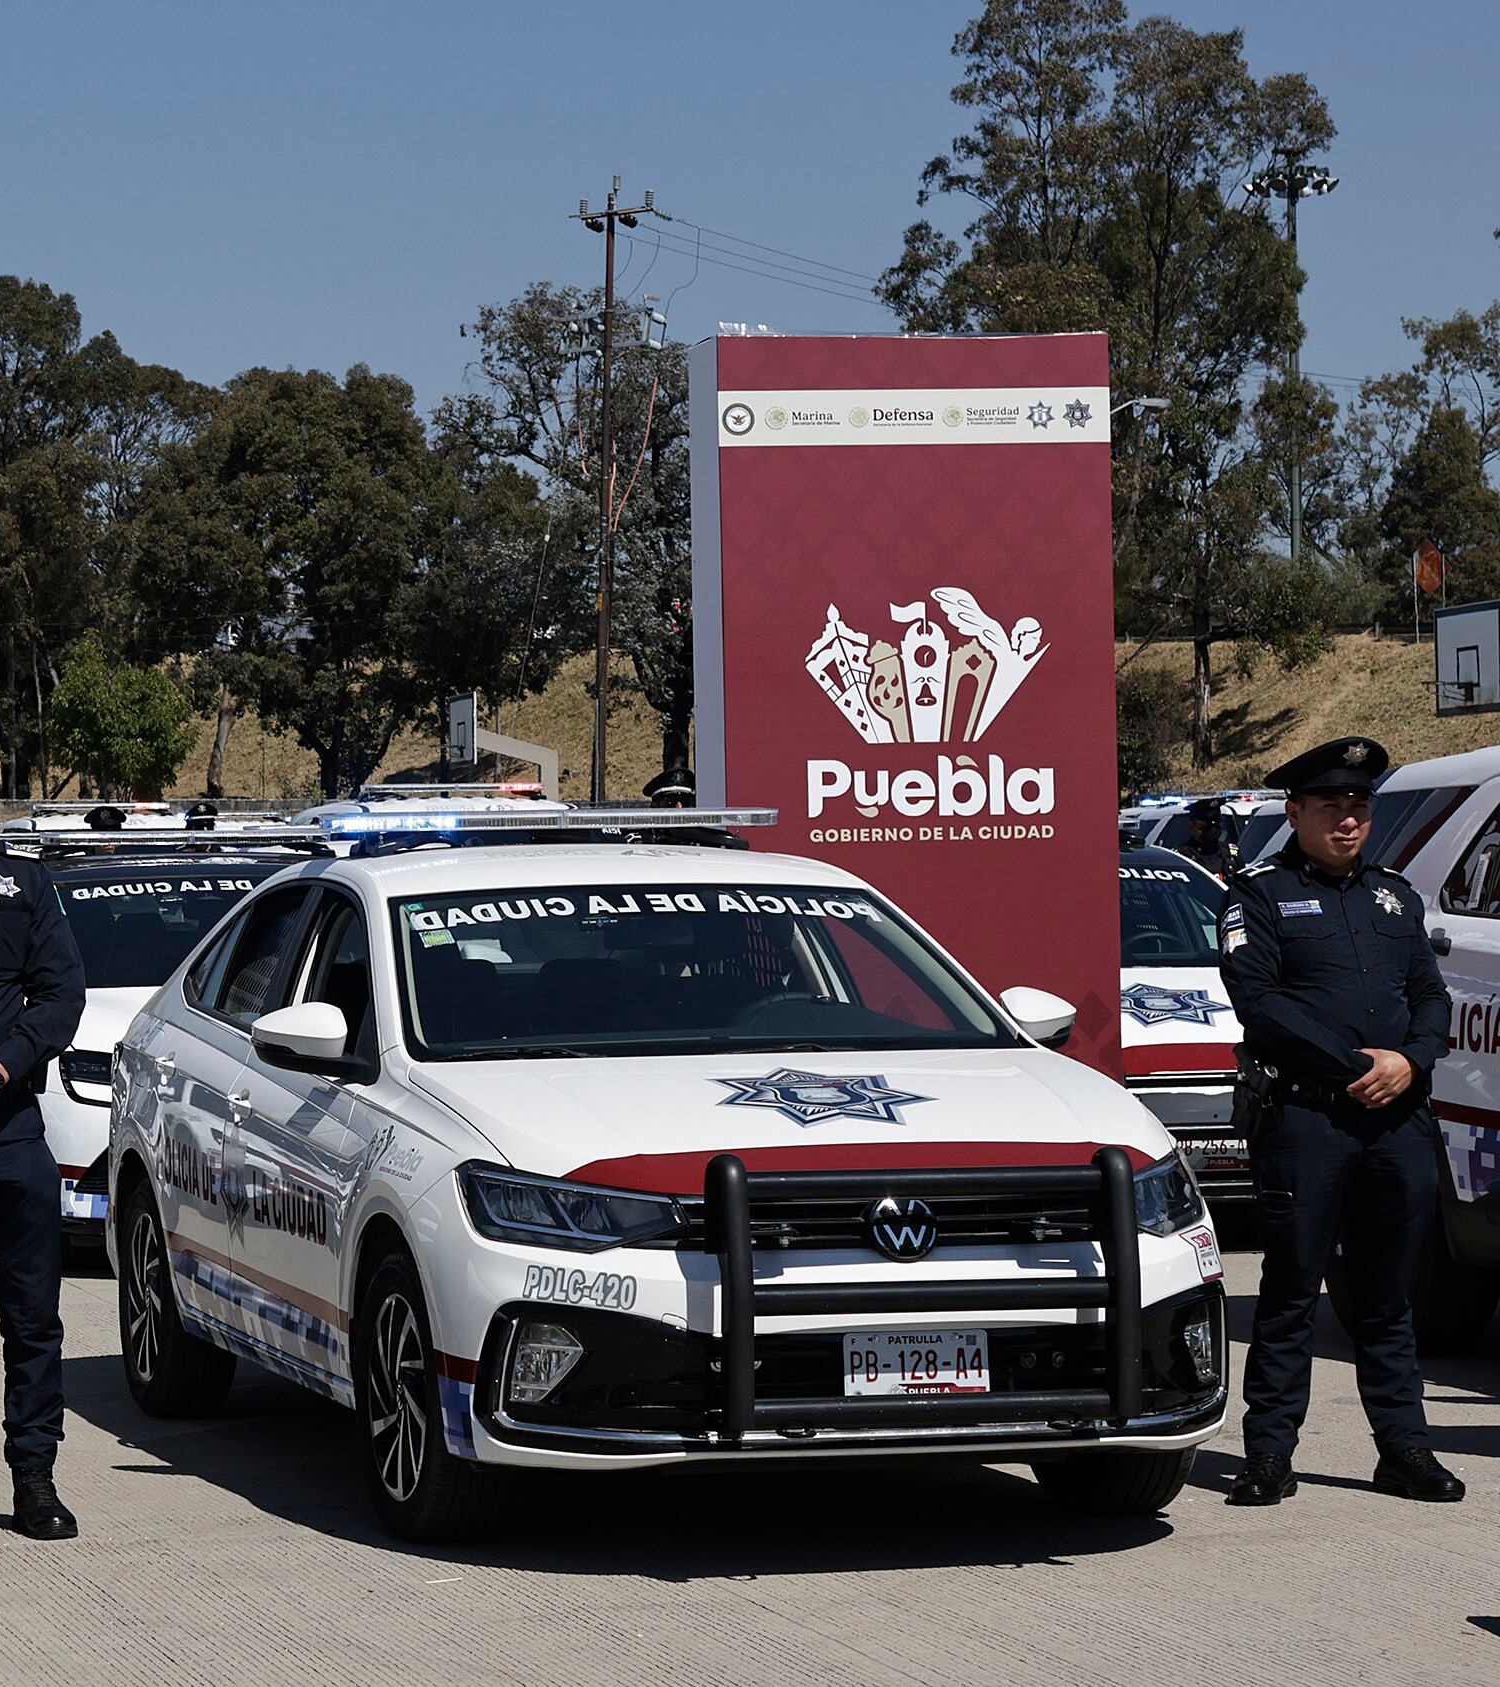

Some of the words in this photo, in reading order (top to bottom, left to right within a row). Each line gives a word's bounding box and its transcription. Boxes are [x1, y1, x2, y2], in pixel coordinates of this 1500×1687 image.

[792, 411, 833, 421] Marina
[873, 408, 934, 421] Defensa
[966, 406, 1019, 417] Seguridad
[806, 754, 1055, 819] Puebla
[809, 827, 914, 843] GOBIERNO
[919, 827, 943, 841] DE
[949, 826, 973, 841] LA
[978, 824, 1055, 840] CIUDAD
[523, 1265, 637, 1310] PDLC-420
[851, 1338, 856, 1346] F
[888, 1334, 943, 1345] PATRULLA
[850, 1347, 983, 1383] PB-128-A4
